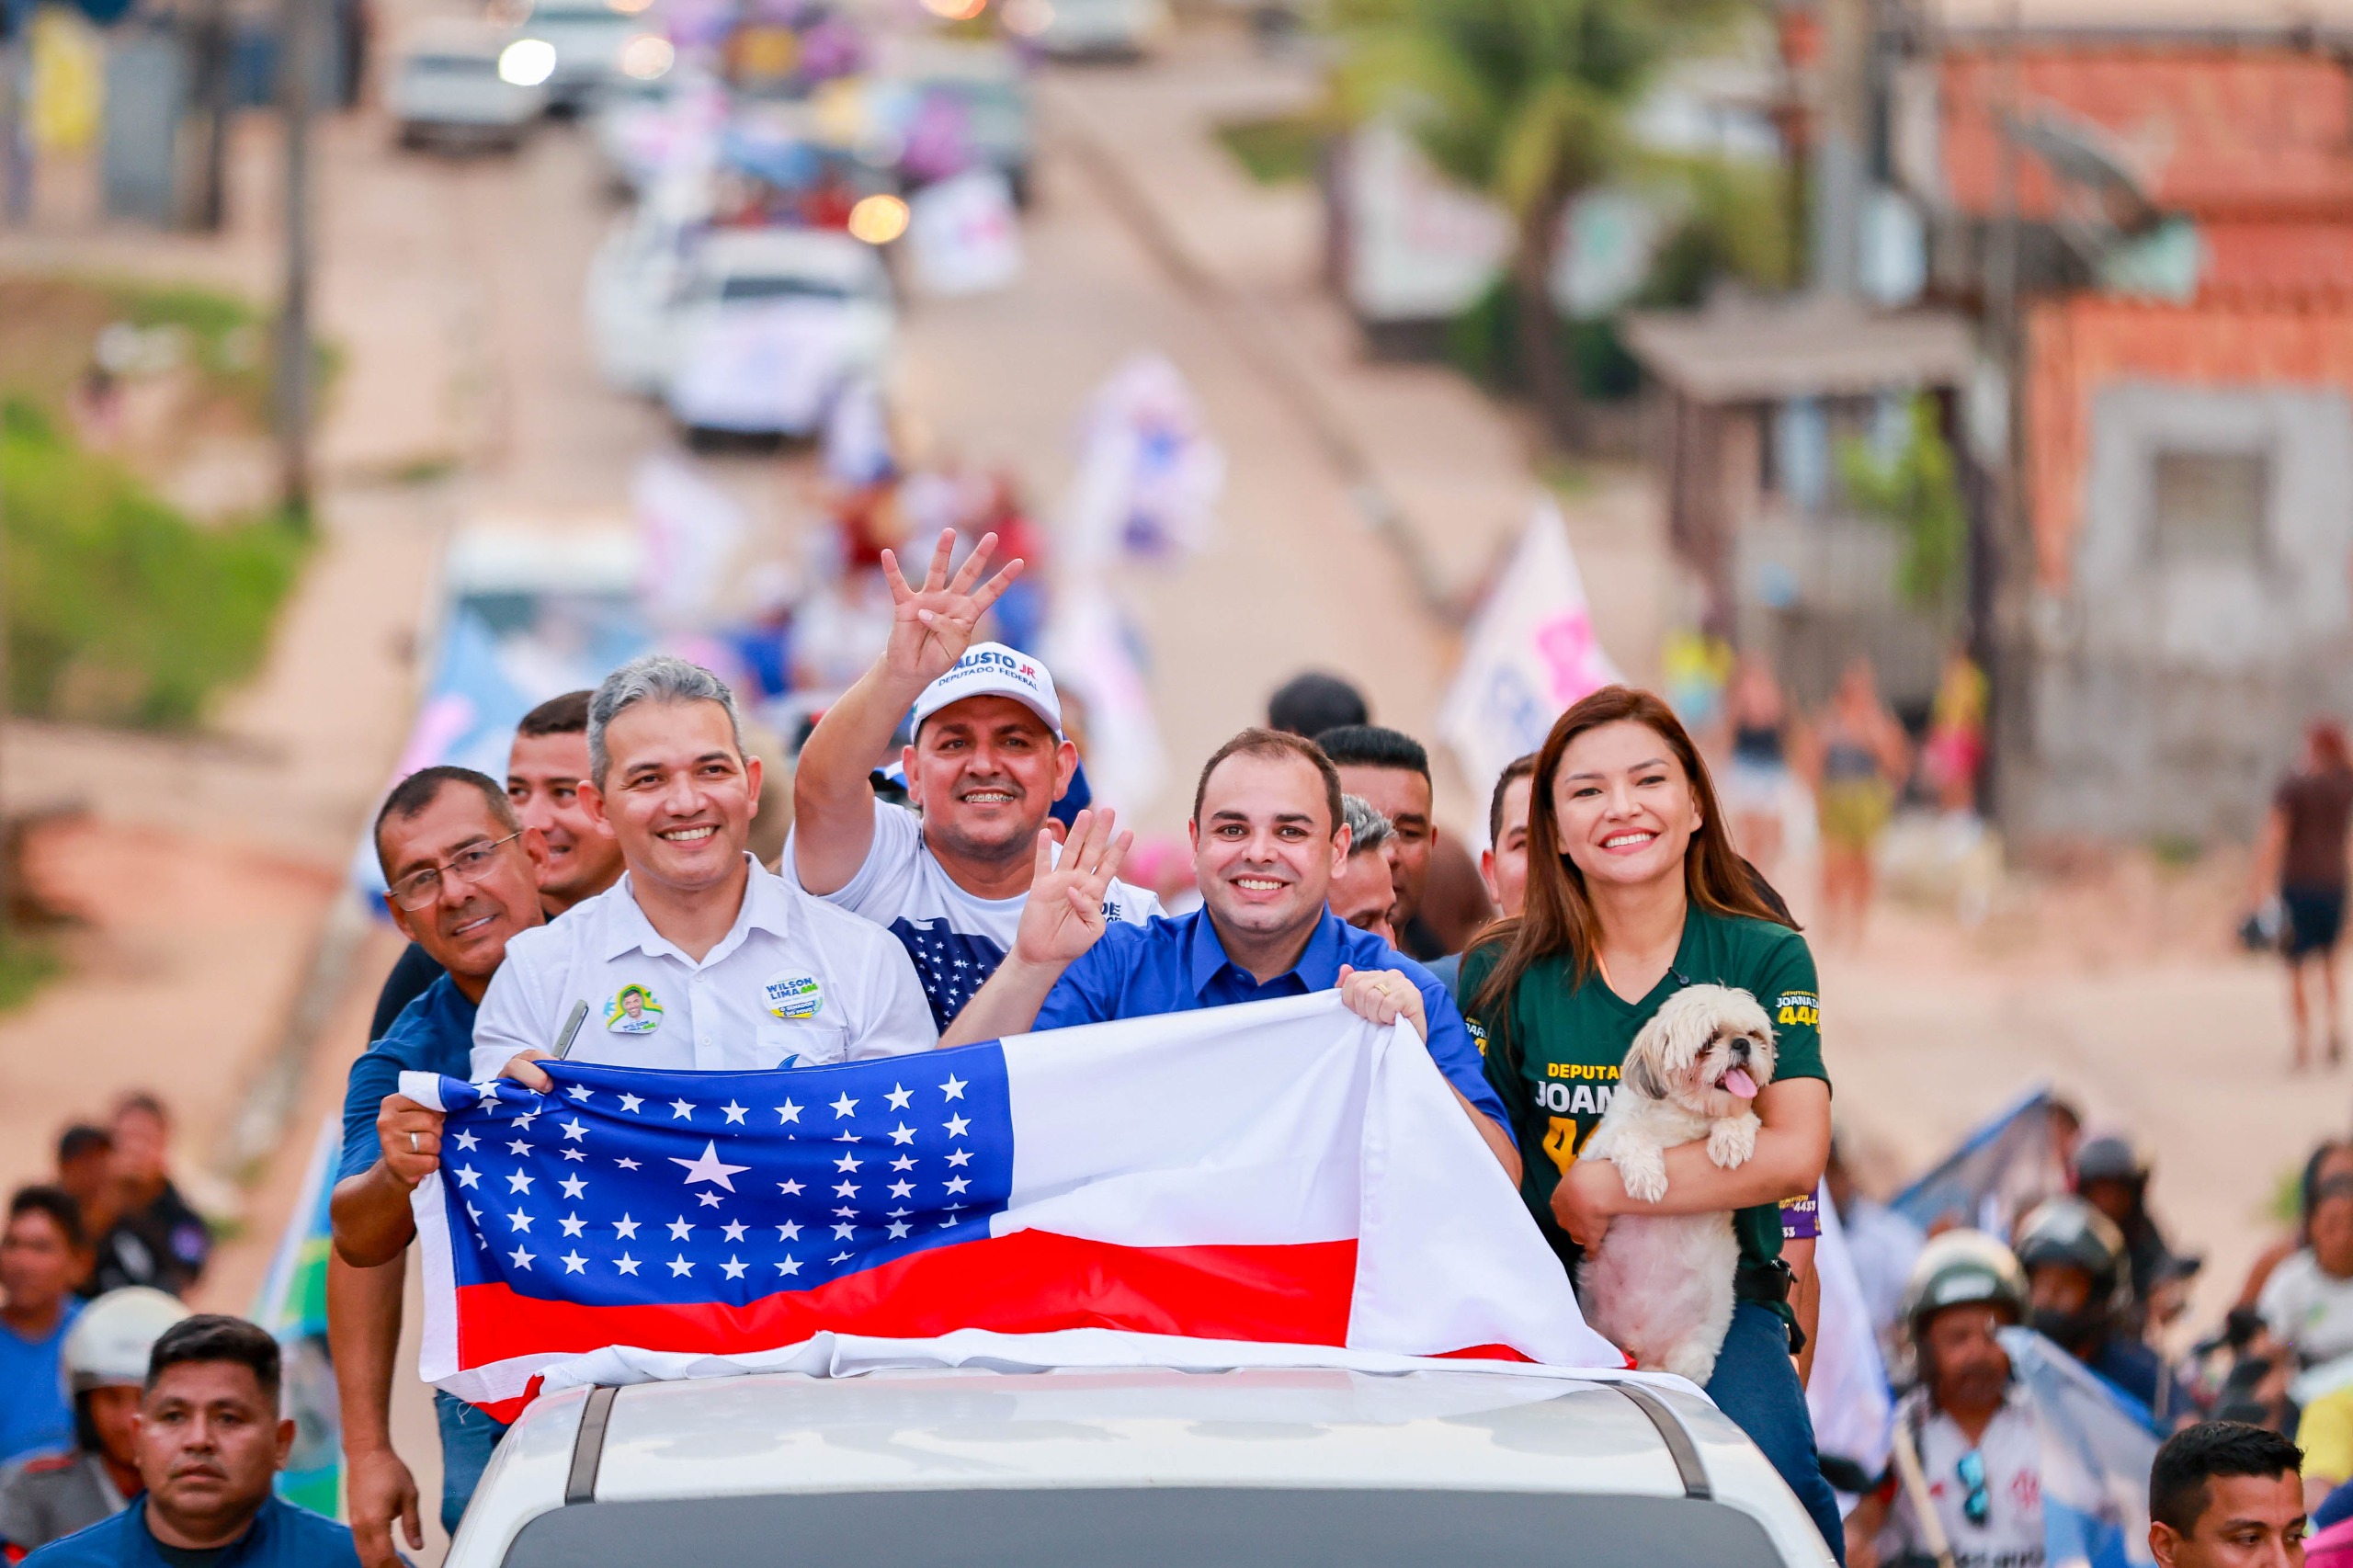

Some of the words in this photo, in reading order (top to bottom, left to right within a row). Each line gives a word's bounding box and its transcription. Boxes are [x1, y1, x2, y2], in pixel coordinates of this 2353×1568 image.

[938, 666, 995, 687] DEPUTADO
[999, 667, 1039, 691] FEDERAL
[766, 977, 813, 993] WILSON
[770, 988, 801, 1000] LIMA
[1548, 1062, 1624, 1080] DEPUTA
[1542, 1115, 1602, 1177] 4
